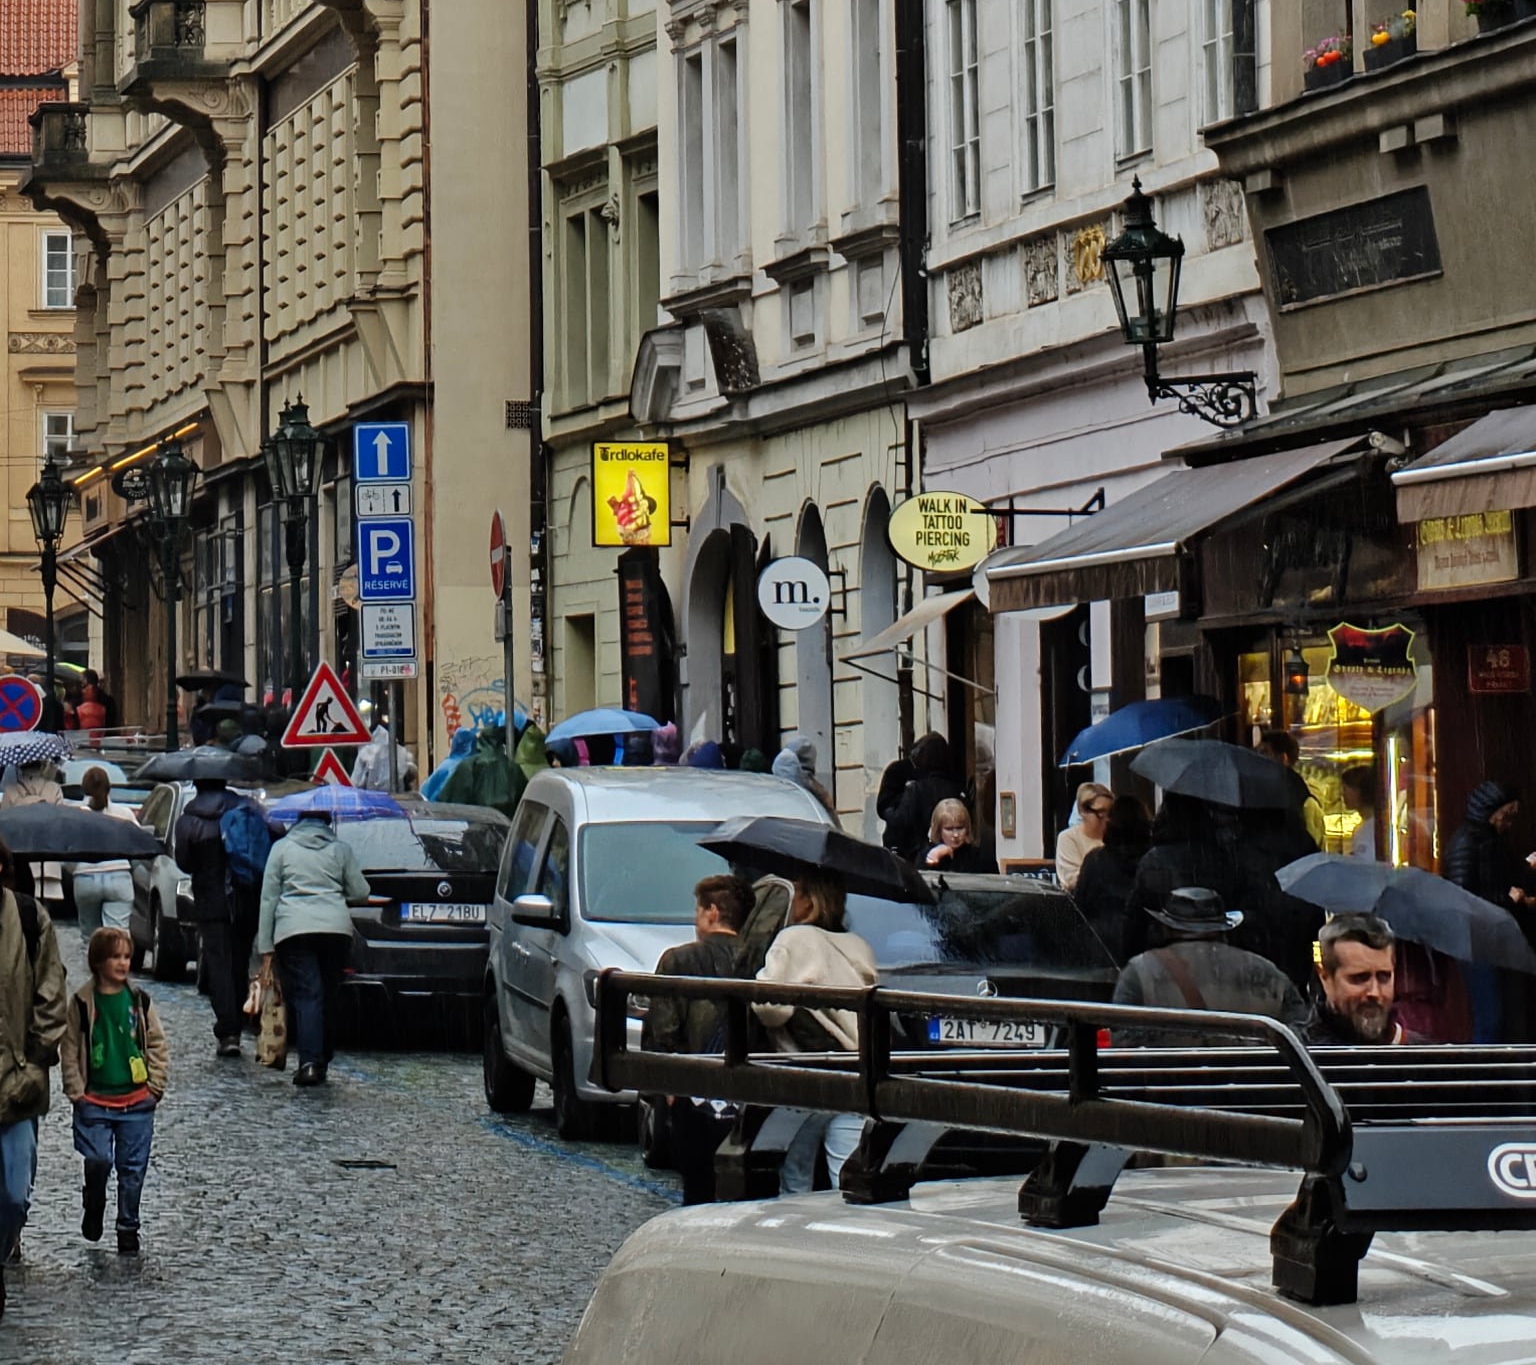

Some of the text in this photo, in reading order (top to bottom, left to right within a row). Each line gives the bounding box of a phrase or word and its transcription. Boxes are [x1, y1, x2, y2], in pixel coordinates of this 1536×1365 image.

[599, 447, 665, 462] Trdlokafe
[918, 498, 967, 514] WALK IN
[922, 514, 963, 530] TATTOO
[916, 531, 970, 547] PIERCING
[944, 1020, 976, 1040] 2AT
